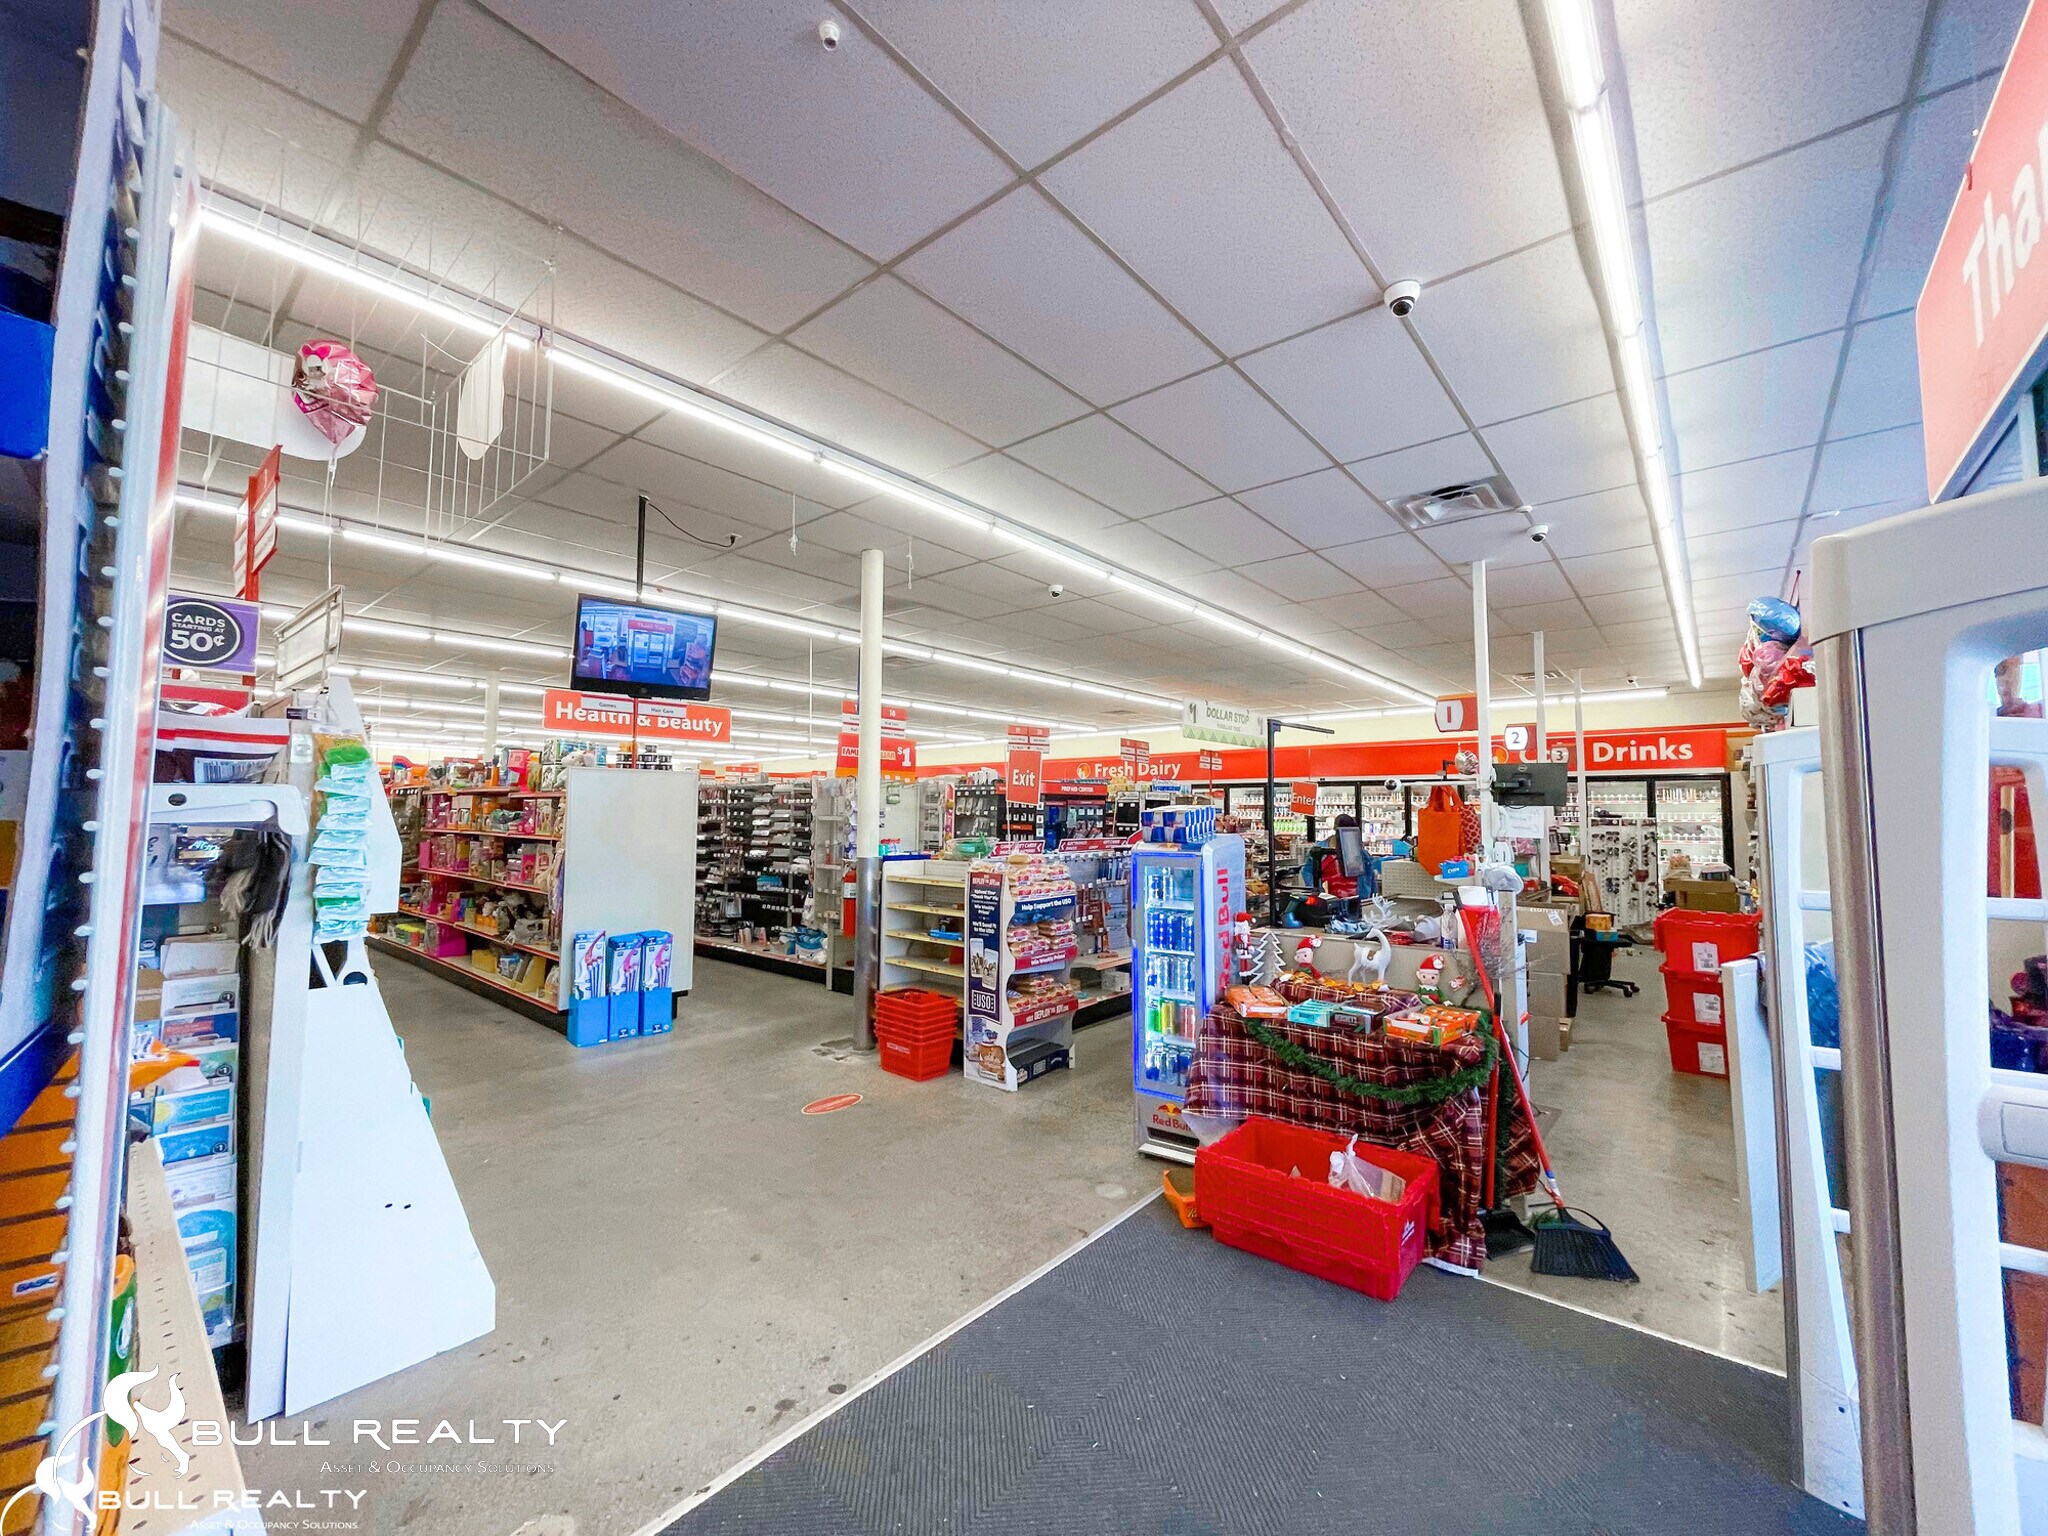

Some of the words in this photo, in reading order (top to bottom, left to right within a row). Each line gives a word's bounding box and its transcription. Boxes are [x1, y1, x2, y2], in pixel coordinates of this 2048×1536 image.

[171, 612, 226, 628] CARDS
[172, 621, 213, 632] STARTING
[170, 629, 226, 652] 50¢
[1206, 705, 1233, 722] DOLLAR
[1234, 712, 1250, 724] STOP
[1446, 706, 1452, 724] 1
[1511, 731, 1521, 744] 2
[898, 746, 912, 767] $1
[1556, 750, 1564, 761] 3
[1592, 737, 1694, 763] Drinks
[1012, 769, 1036, 788] Exit
[1094, 760, 1134, 778] Fresh
[1138, 760, 1182, 780] Dairy
[1292, 792, 1316, 806] Enter
[1216, 868, 1230, 926] Bull
[1034, 902, 1054, 910] Support
[976, 992, 990, 1009] USO
[1152, 1114, 1171, 1128] Red
